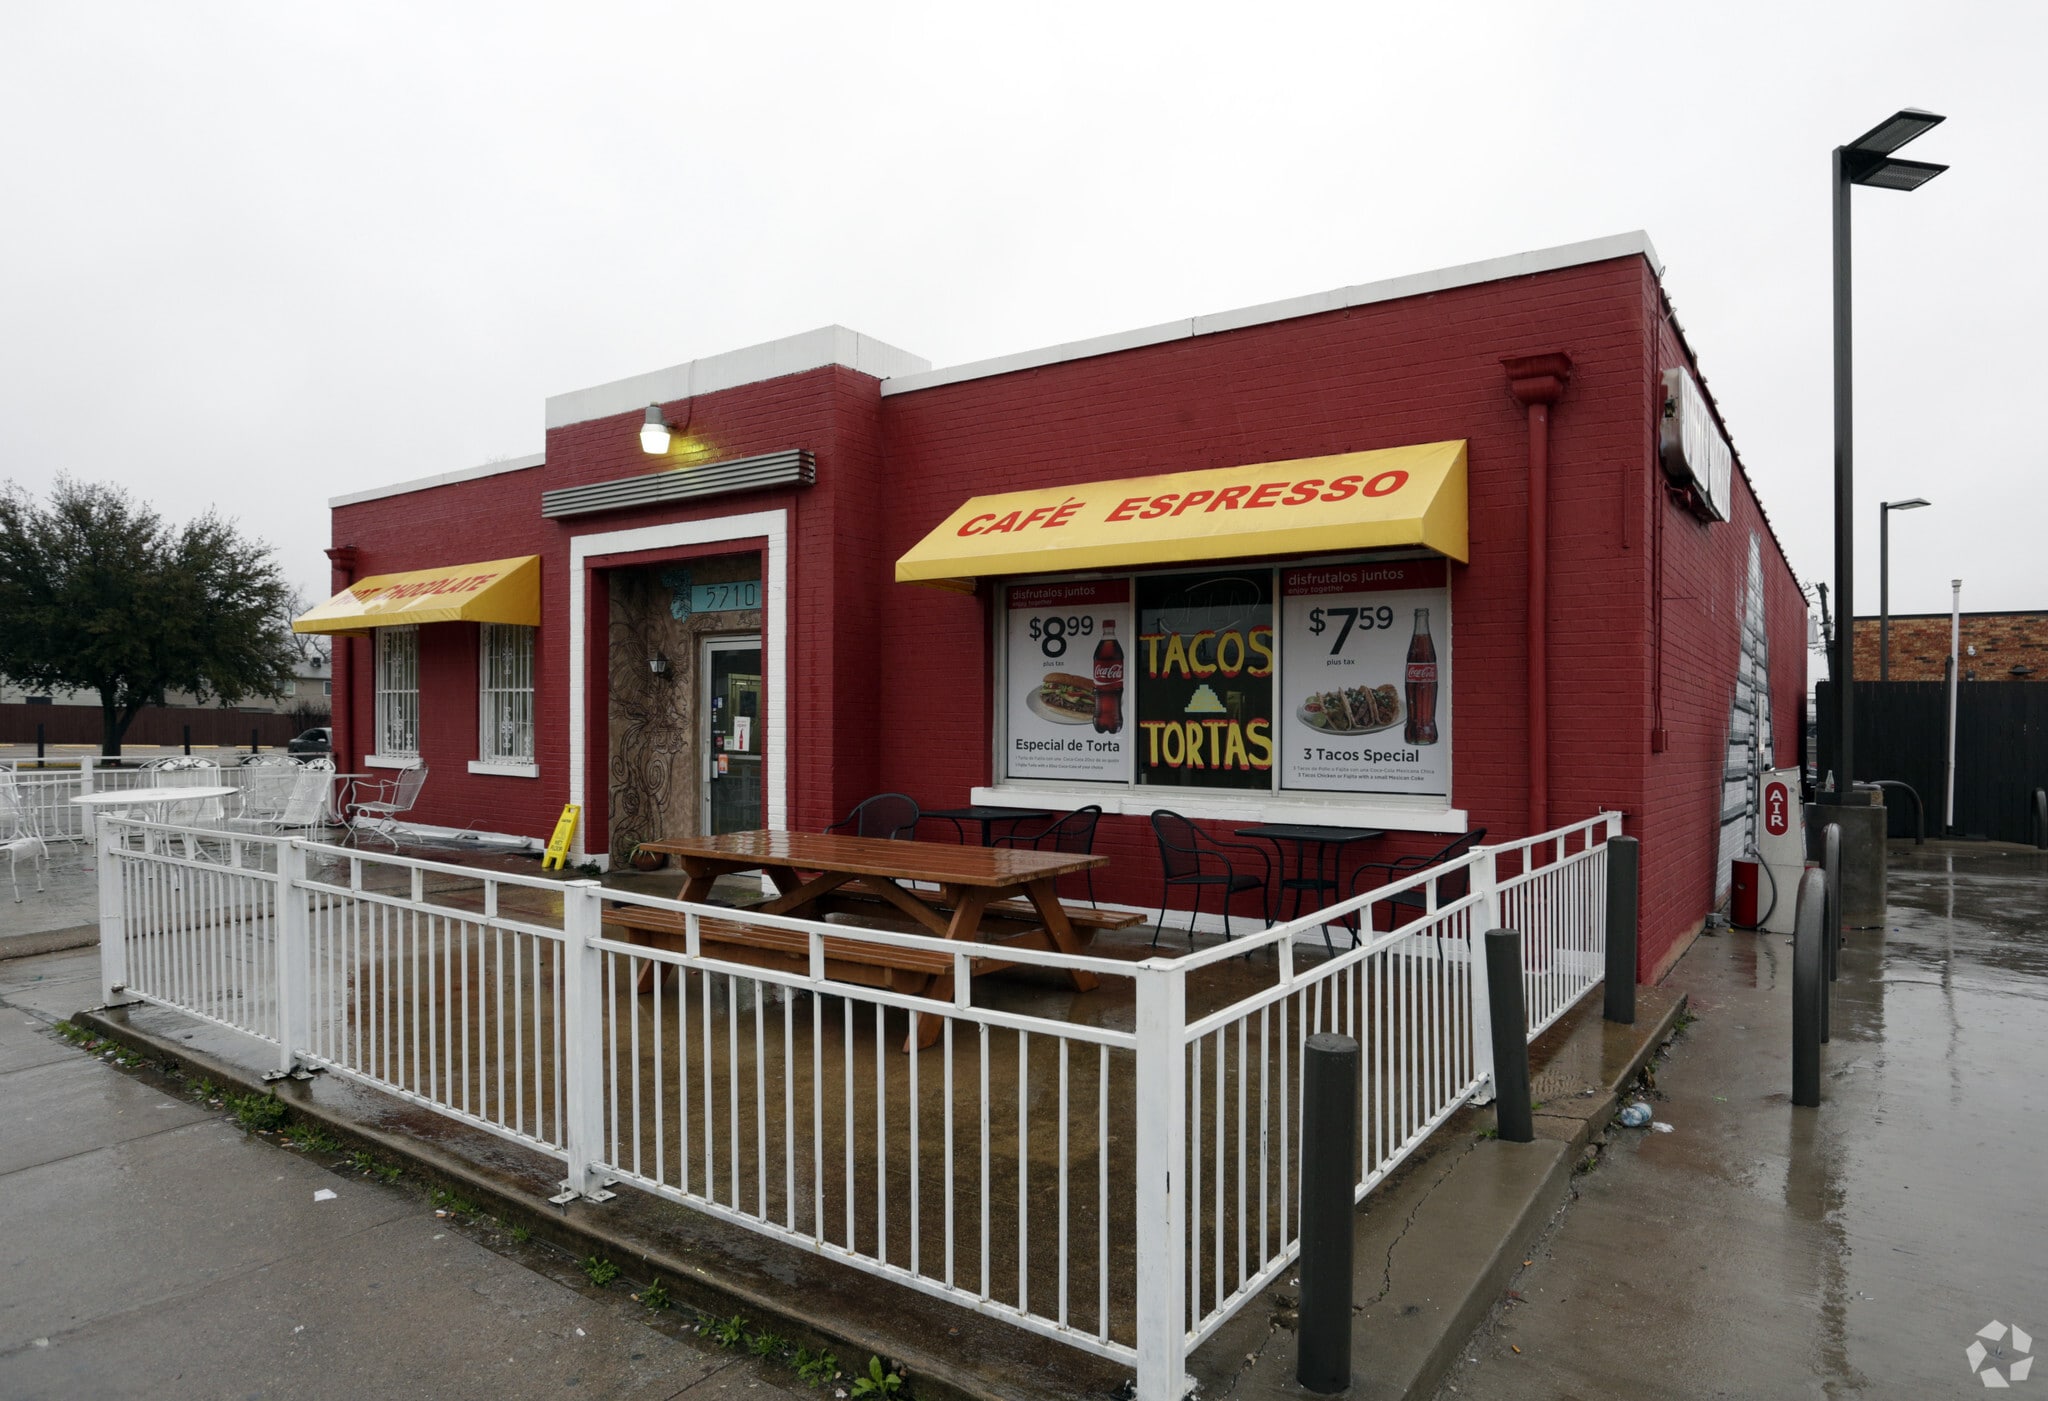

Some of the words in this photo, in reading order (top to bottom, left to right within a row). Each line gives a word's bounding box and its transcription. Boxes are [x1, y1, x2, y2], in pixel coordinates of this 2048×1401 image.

[956, 497, 1086, 537] CAFÉ
[1104, 470, 1409, 522] ESPRESSO
[1288, 571, 1357, 586] disfrutalos
[1361, 570, 1404, 584] juntos
[706, 584, 755, 608] 5710
[1012, 588, 1063, 600] disfrutalos
[1064, 586, 1096, 599] juntos
[1288, 587, 1309, 595] enjoy
[1310, 585, 1344, 594] together
[1139, 624, 1272, 679] TACOS
[1015, 738, 1065, 753] Especial
[1067, 739, 1083, 752] de
[1086, 740, 1120, 753] Torta
[1140, 718, 1272, 770] TORTAS
[1303, 748, 1312, 760] 3
[1316, 748, 1360, 761] Tacos
[1363, 749, 1419, 764] Special
[1769, 789, 1784, 827] AIR
